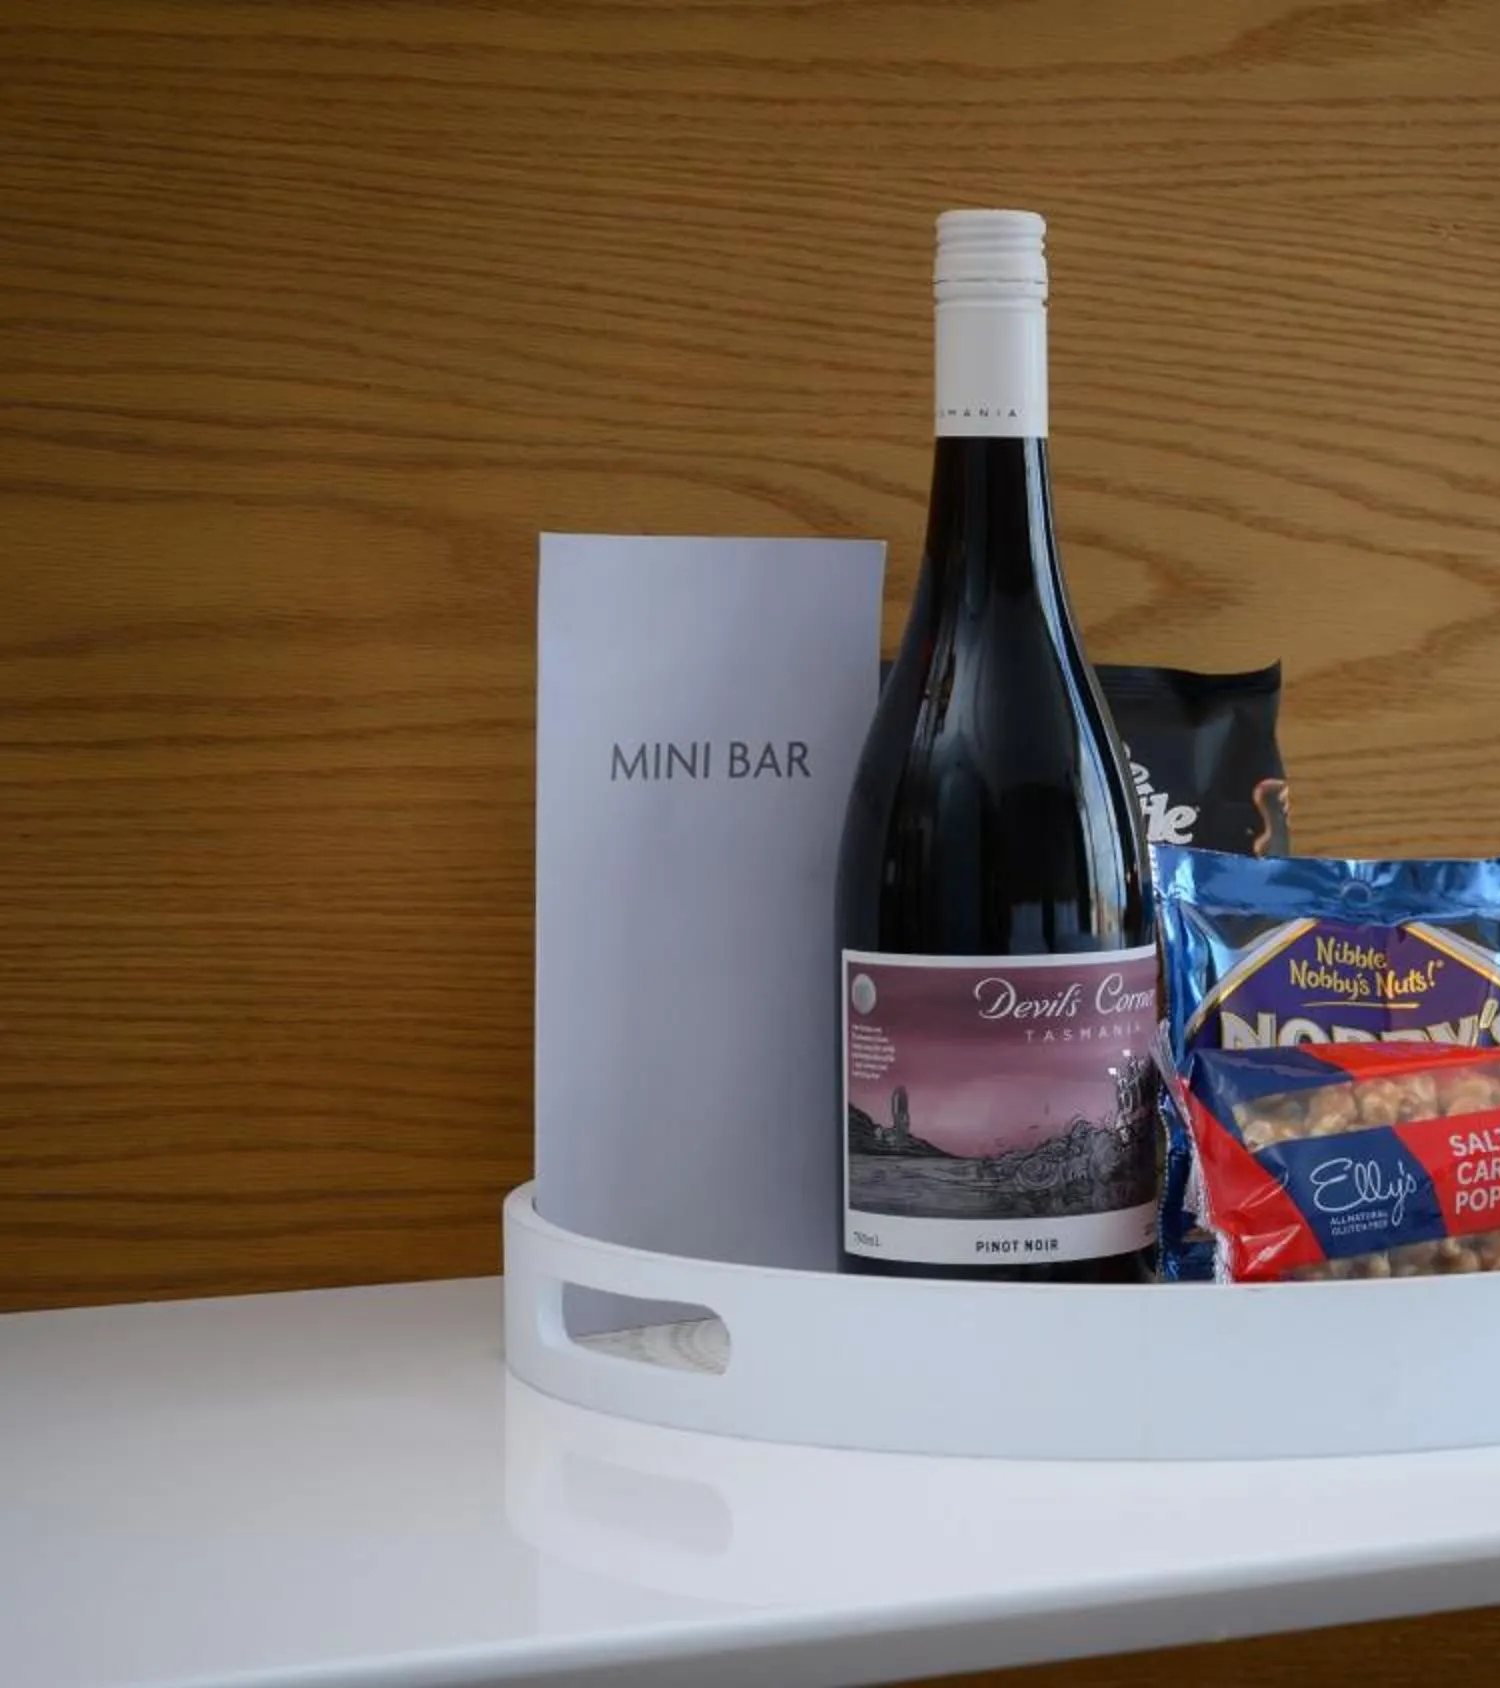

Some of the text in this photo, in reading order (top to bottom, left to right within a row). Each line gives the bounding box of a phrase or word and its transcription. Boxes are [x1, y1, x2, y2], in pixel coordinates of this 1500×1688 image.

[611, 741, 812, 781] MINI BAR
[1316, 936, 1389, 970] Nibble
[1289, 959, 1370, 1000] Nobby's
[1309, 1157, 1418, 1227] Elly's
[976, 1238, 1059, 1252] PINOT NOIR
